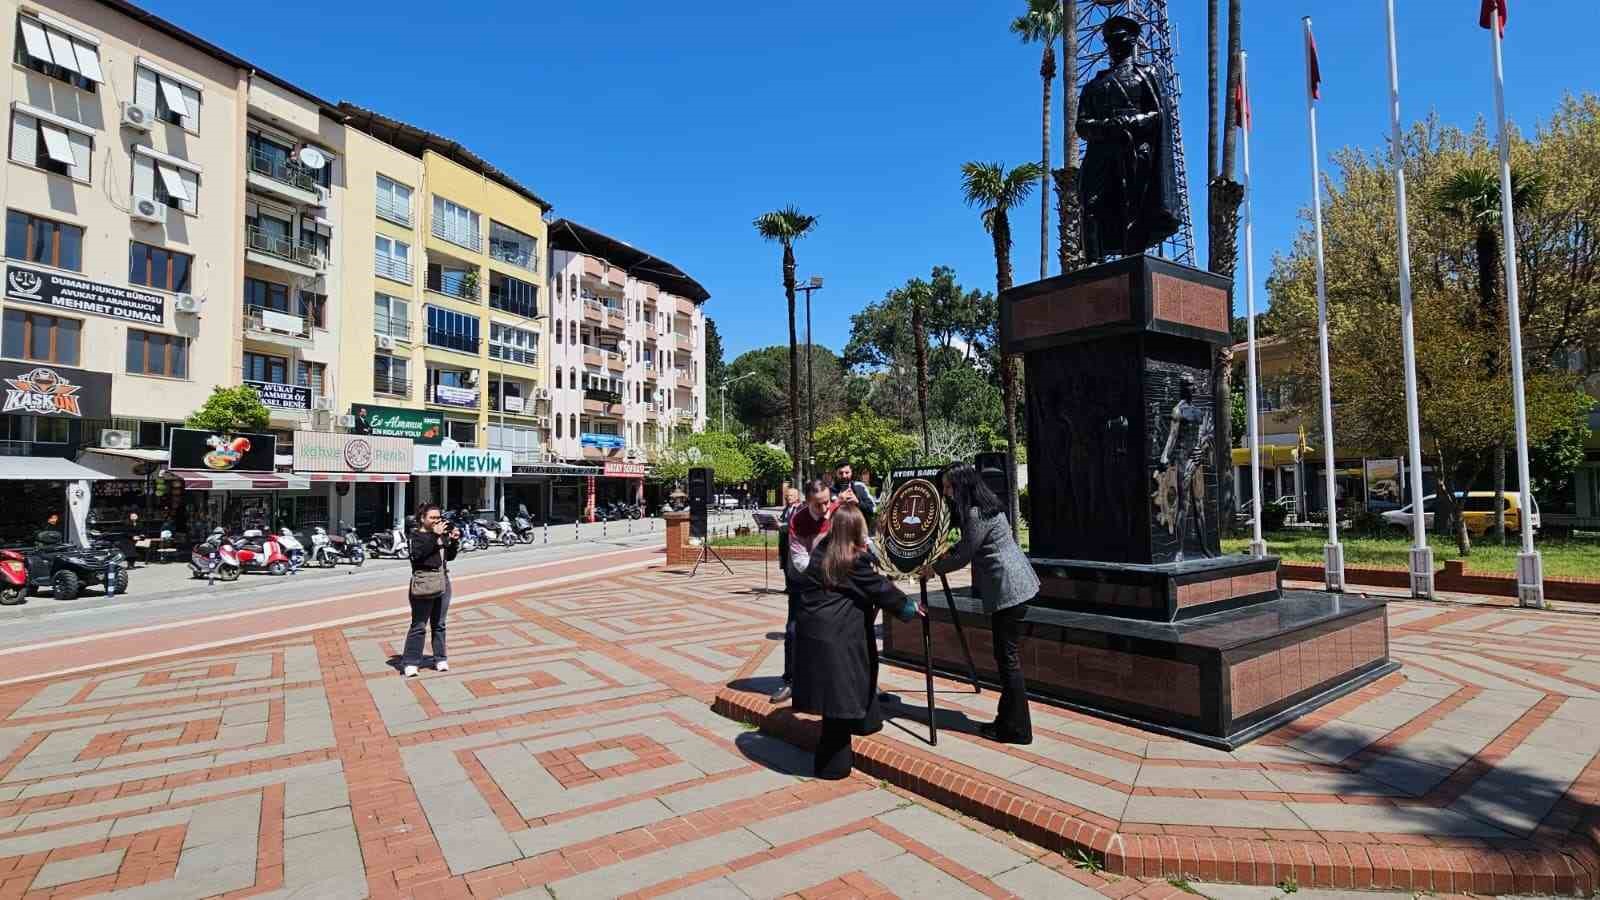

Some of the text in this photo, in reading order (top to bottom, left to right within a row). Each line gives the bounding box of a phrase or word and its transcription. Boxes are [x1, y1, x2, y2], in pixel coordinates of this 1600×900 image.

[51, 276, 162, 305] DUMAN HUKUK BÜROSU
[60, 288, 97, 302] AVUKAT
[106, 297, 155, 312] ARABULUCU
[52, 296, 161, 323] MEHMET DUMAN
[263, 384, 294, 393] AVUKAT
[428, 450, 502, 472] EMİNEVİM
[917, 469, 938, 477] BARO
